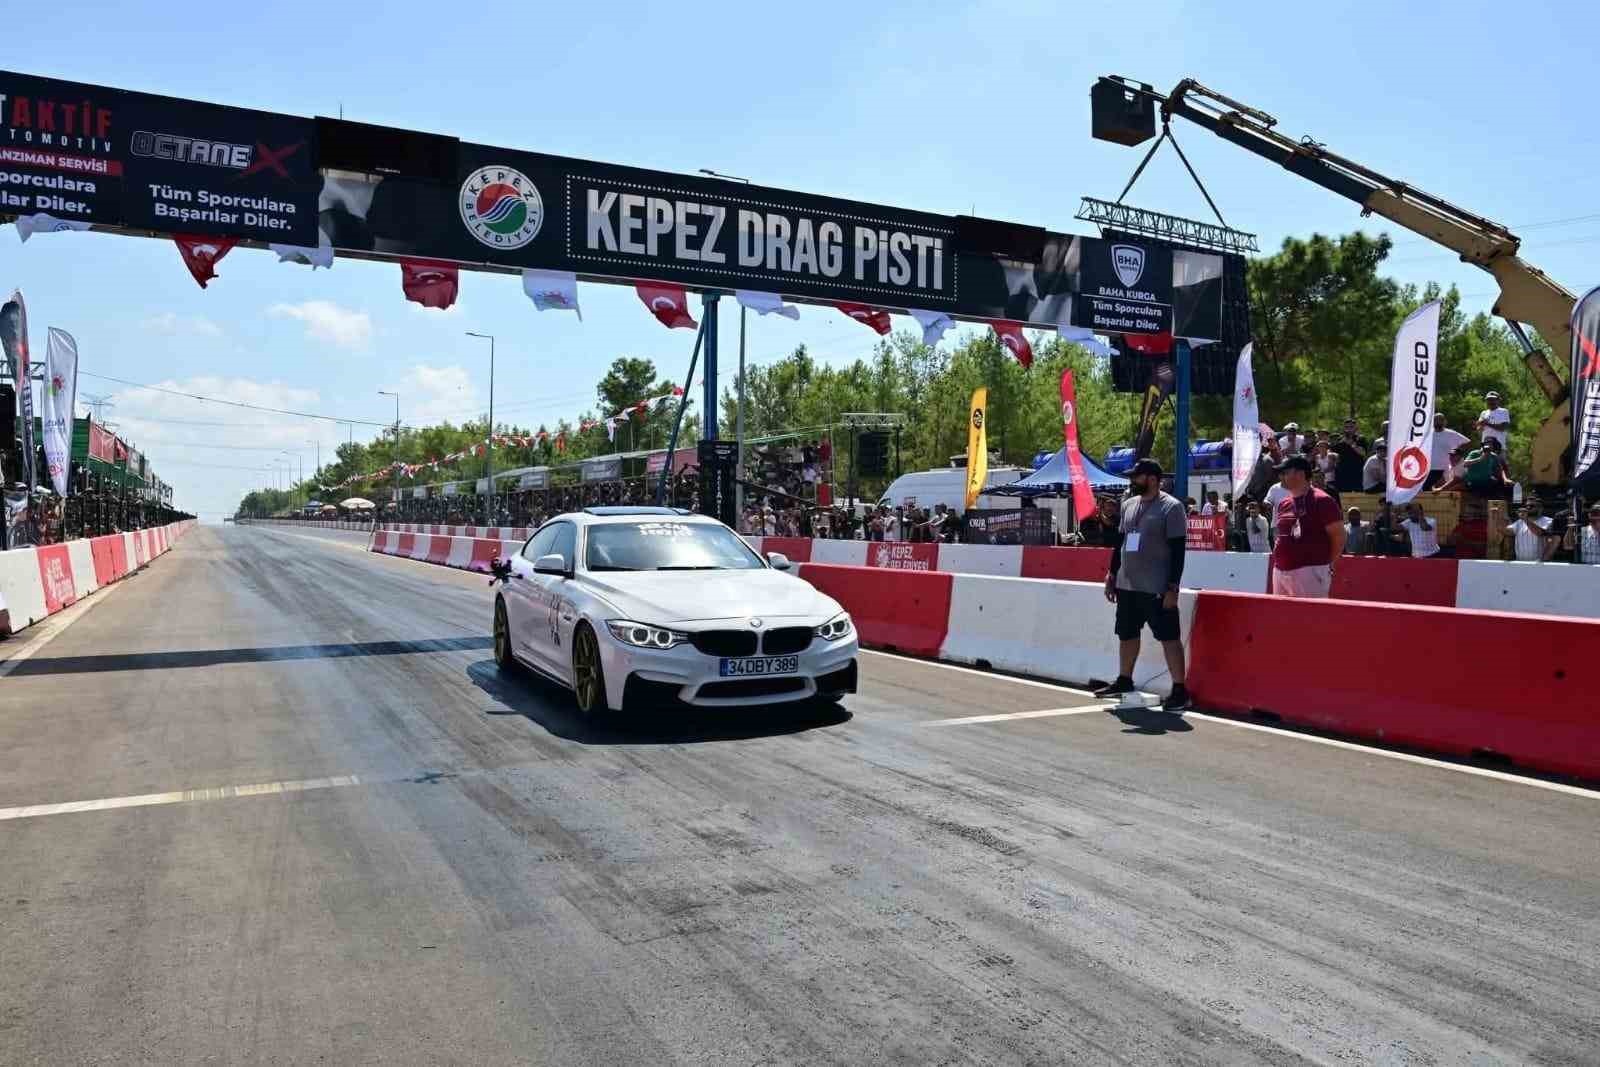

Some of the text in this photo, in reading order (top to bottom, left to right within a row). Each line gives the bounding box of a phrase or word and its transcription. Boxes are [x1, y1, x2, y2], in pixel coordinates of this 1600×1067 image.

[0, 149, 108, 173] NZIMAN SERVİSİ
[468, 171, 535, 202] KEPEZ
[36, 195, 92, 214] Diler.
[149, 184, 297, 214] Tüm Sporculara
[154, 203, 292, 231] Başarılar Diler.
[586, 188, 726, 265] KEPEZ
[738, 208, 843, 278] DRAG
[1117, 255, 1139, 266] BHA
[1099, 286, 1124, 298] BAHA
[1092, 300, 1162, 317] Tüm Sporculara
[1094, 314, 1160, 330] Başarılar Diler.
[1409, 341, 1430, 442] TOSFED
[891, 544, 913, 559] KEPEZ
